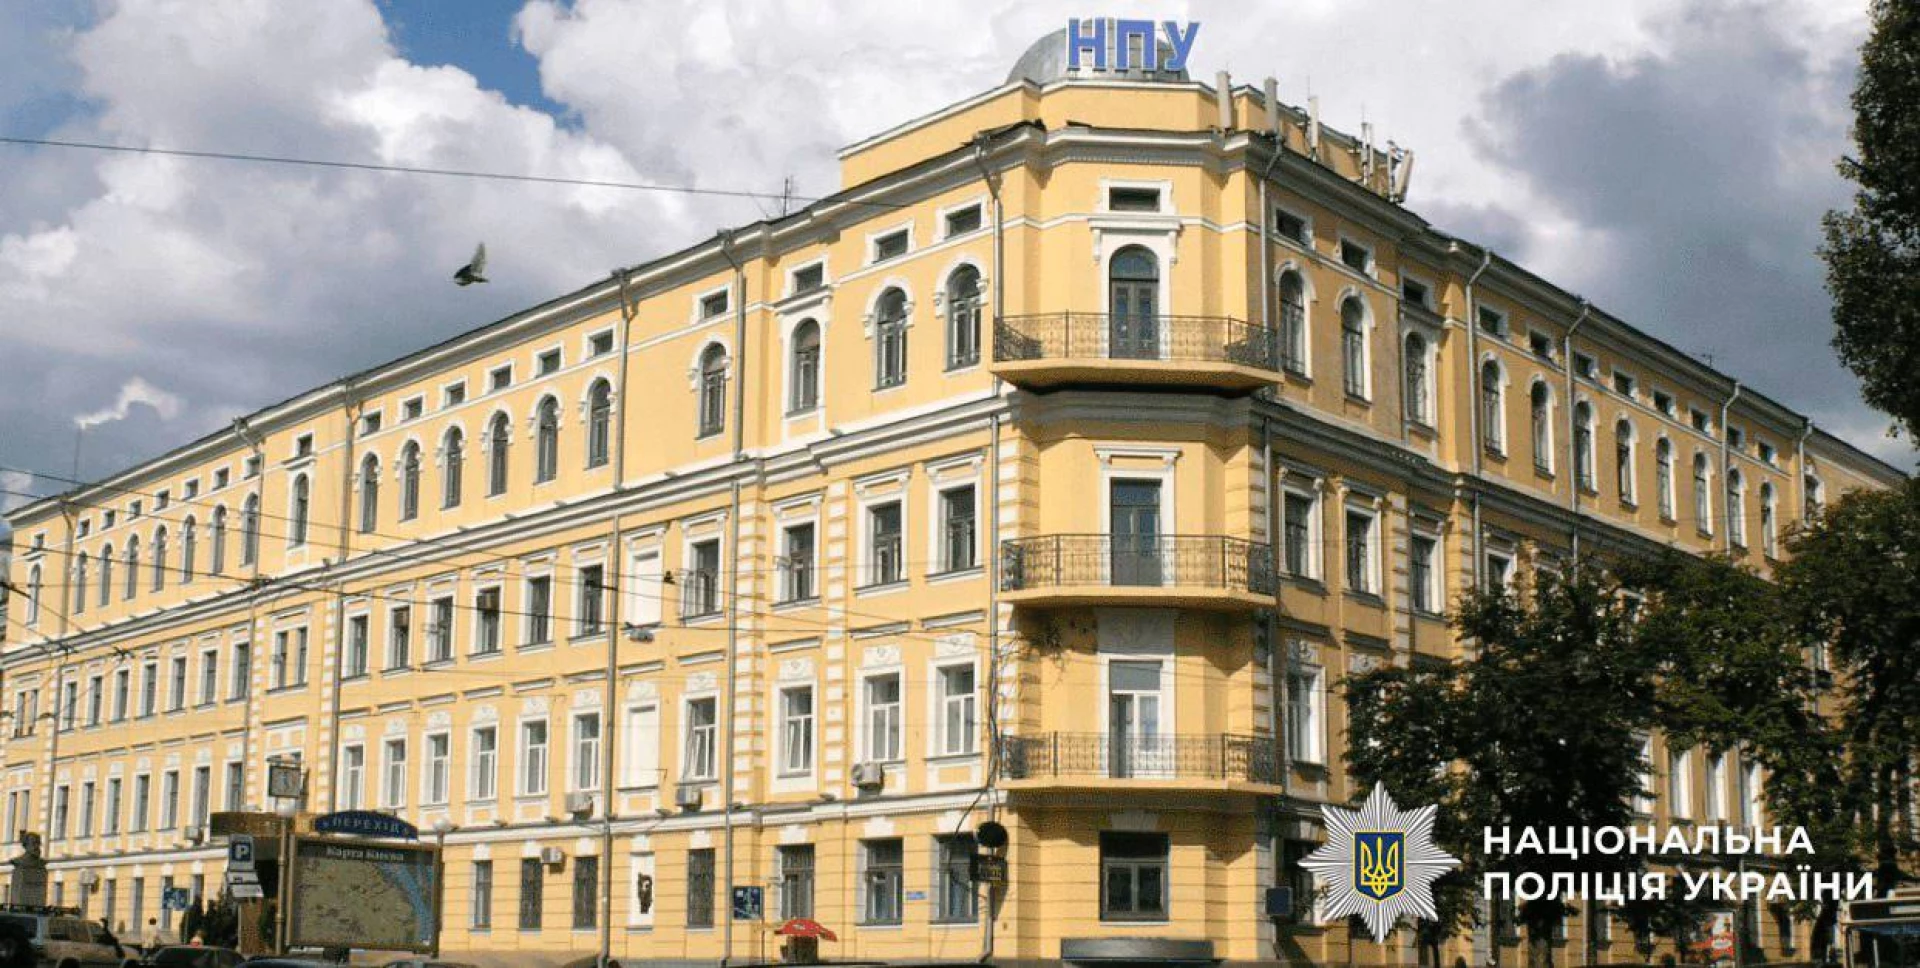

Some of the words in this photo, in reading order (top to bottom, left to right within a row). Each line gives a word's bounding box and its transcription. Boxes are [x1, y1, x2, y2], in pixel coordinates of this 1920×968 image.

[1067, 18, 1200, 70] НПУ
[235, 844, 249, 859] P
[326, 846, 364, 859] Карта
